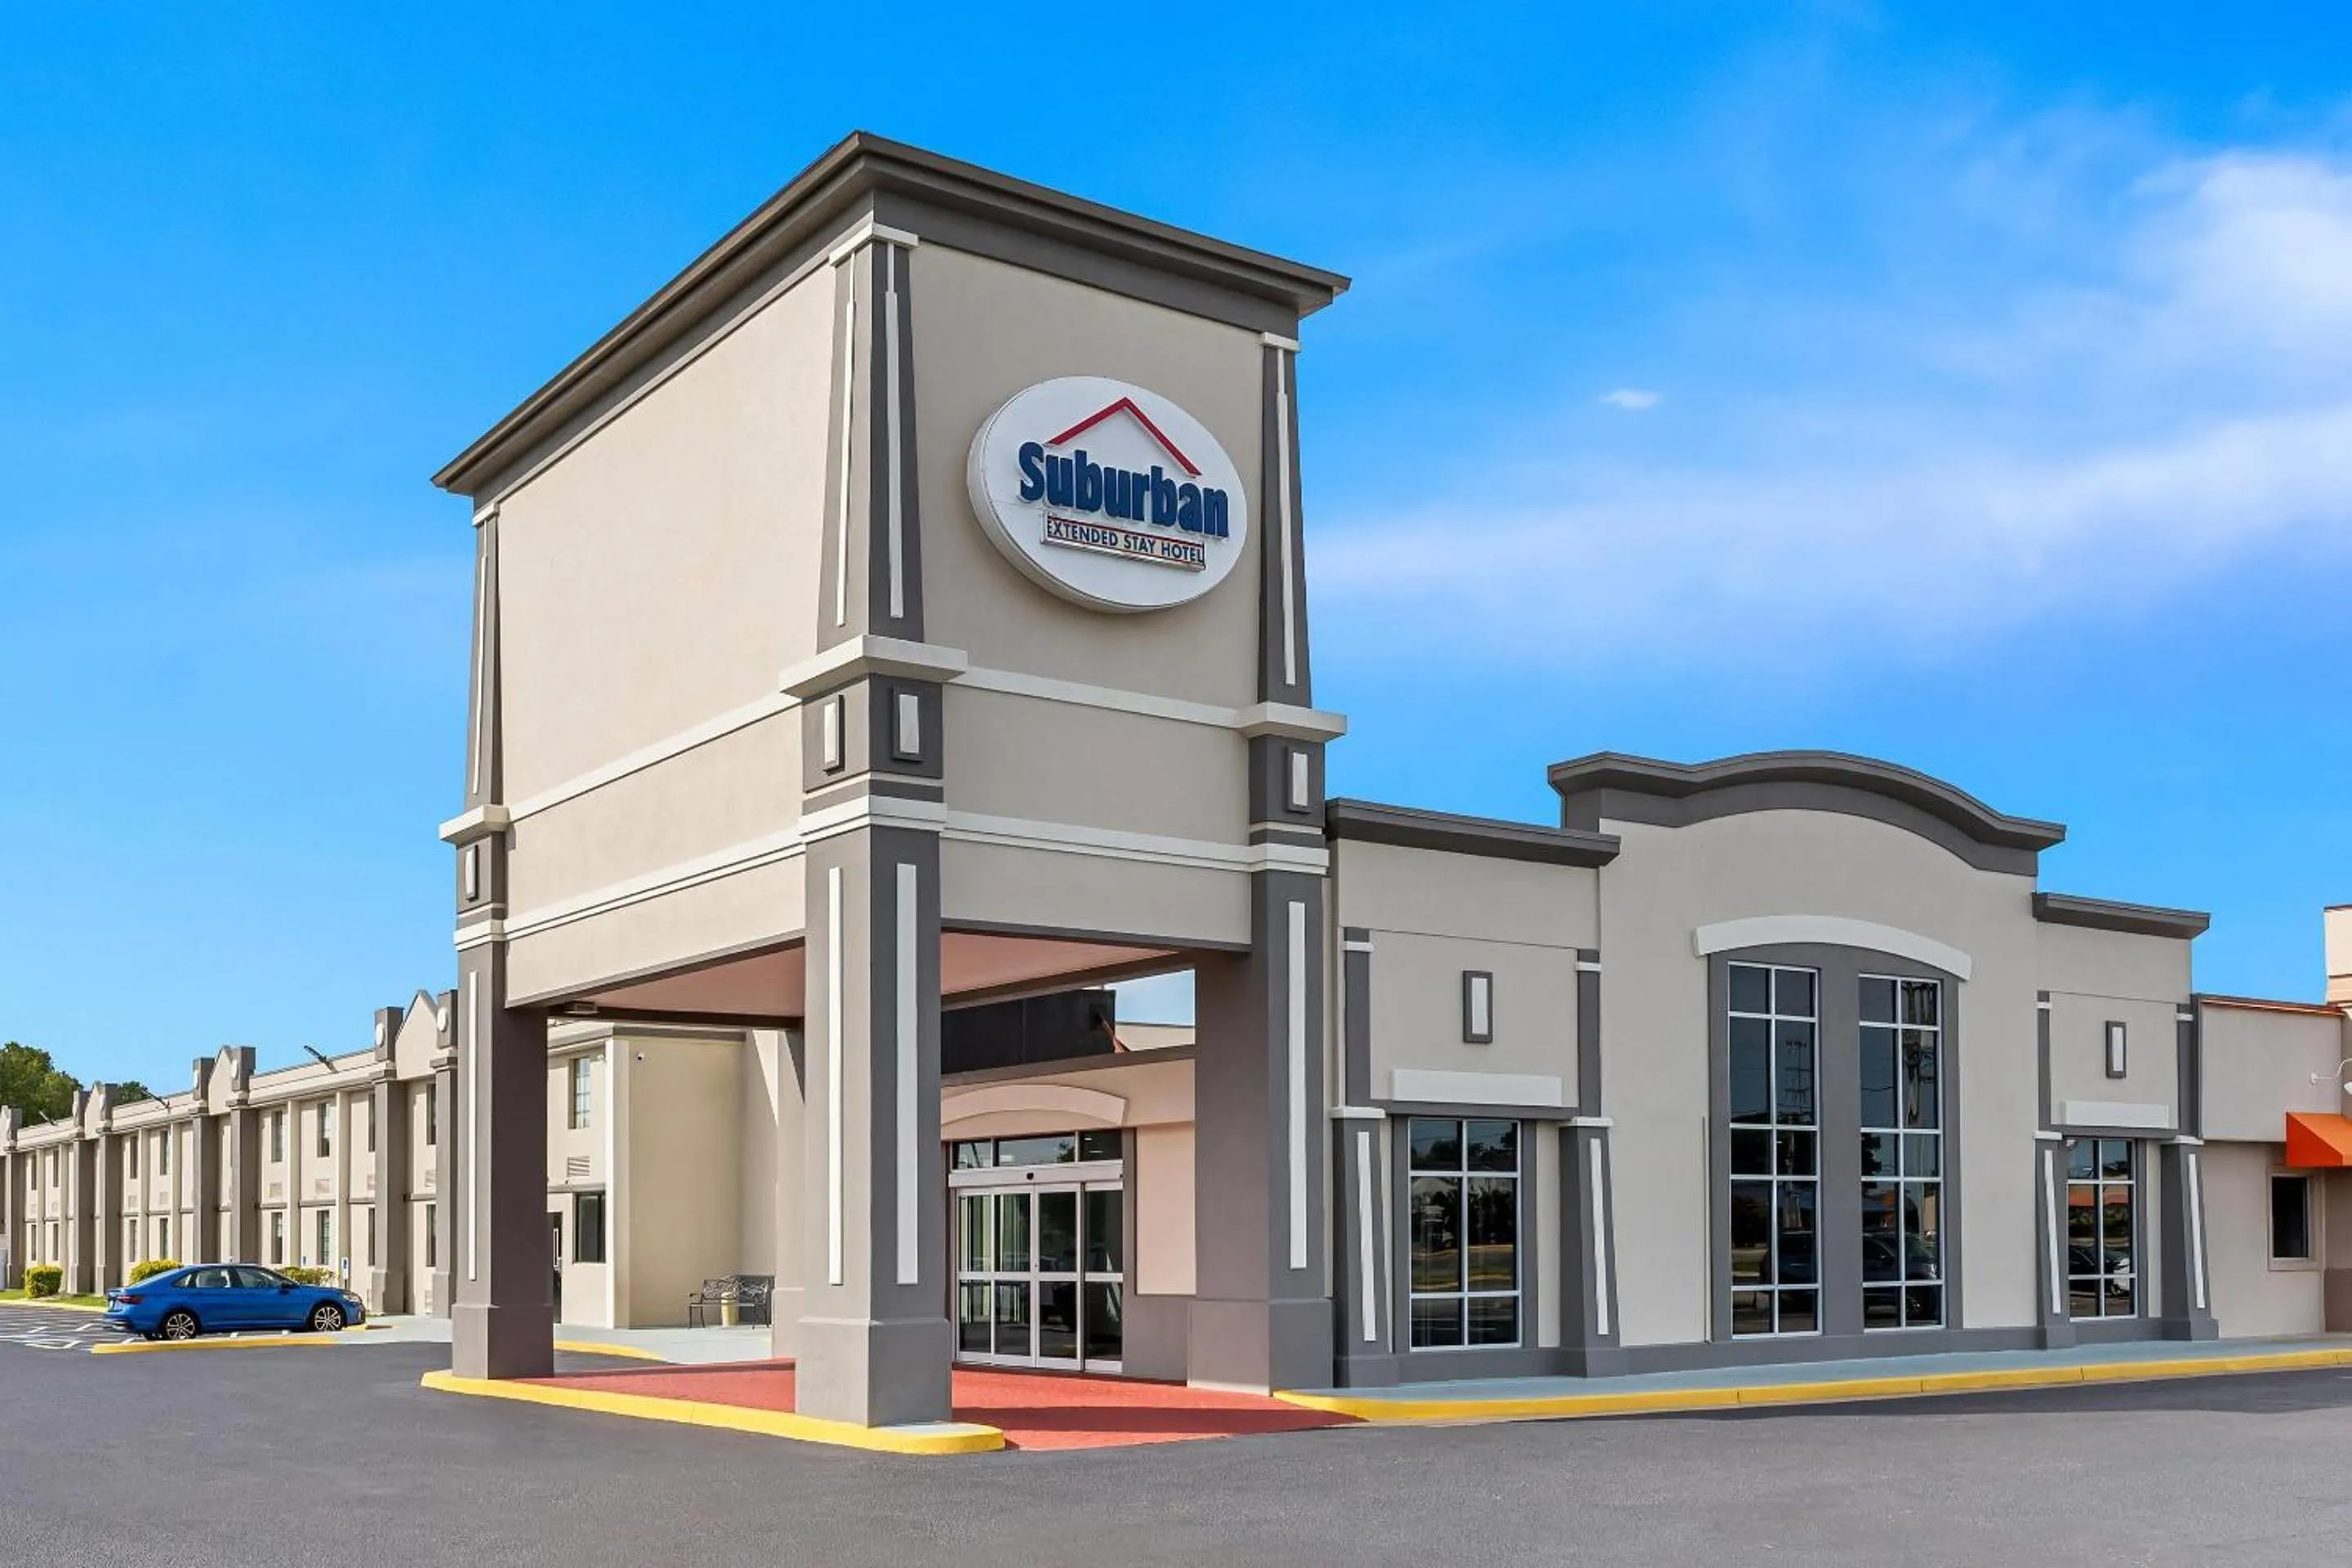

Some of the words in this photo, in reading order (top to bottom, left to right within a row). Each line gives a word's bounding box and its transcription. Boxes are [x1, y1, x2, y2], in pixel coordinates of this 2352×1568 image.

[1018, 442, 1229, 537] Suburban
[1047, 519, 1118, 546] EXTENDED
[1123, 535, 1156, 554] STAY
[1161, 542, 1203, 563] HOTEL
